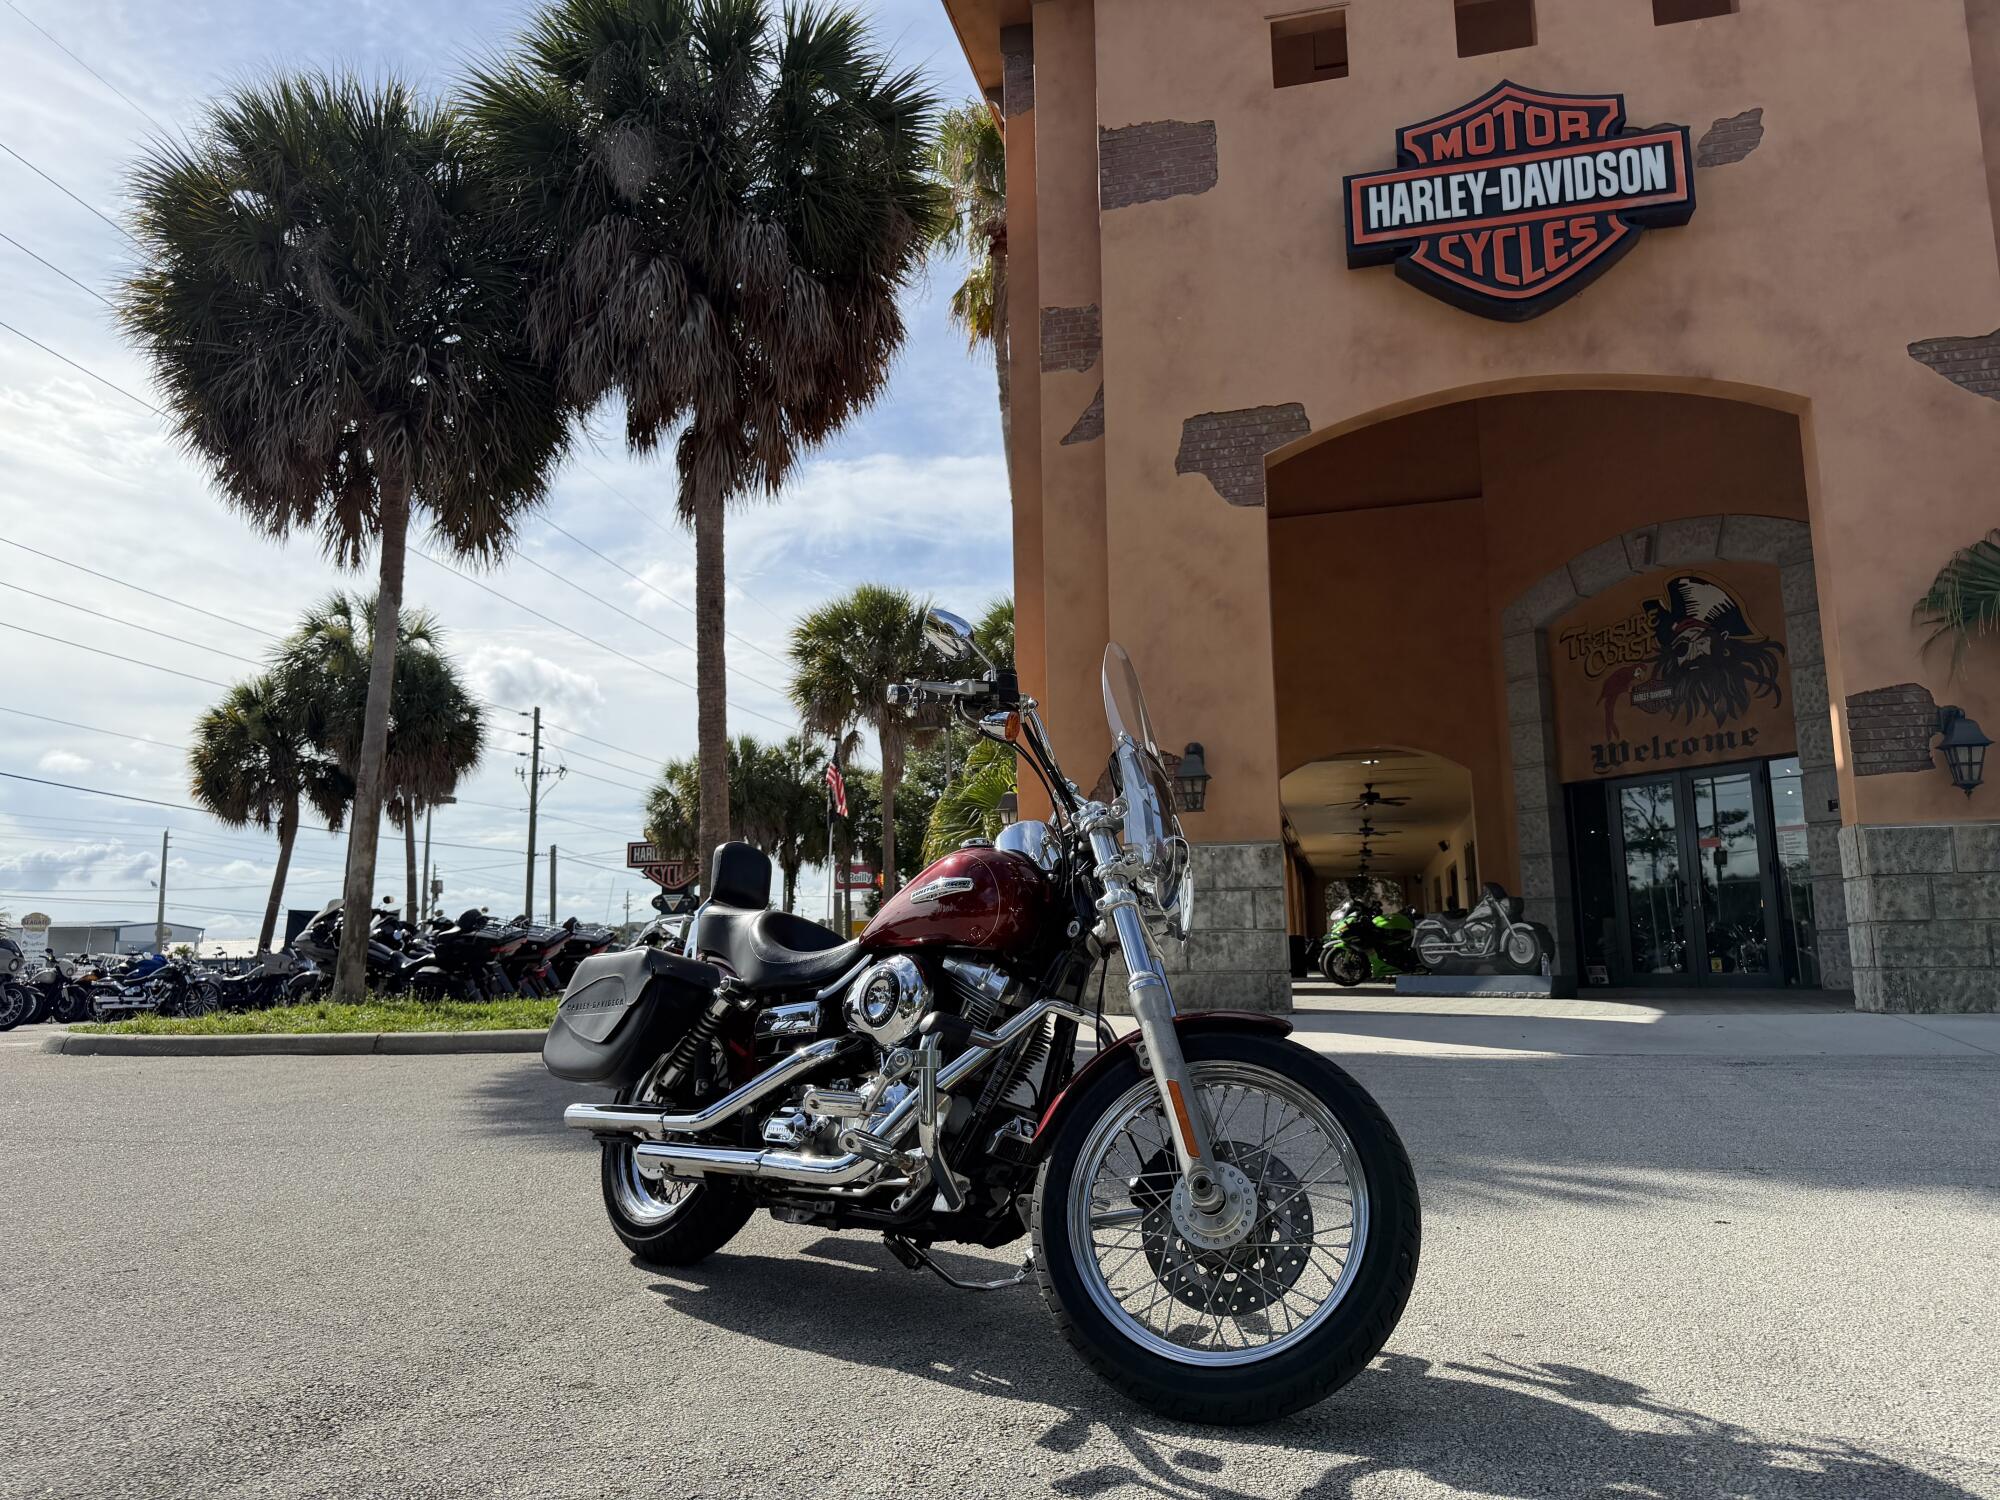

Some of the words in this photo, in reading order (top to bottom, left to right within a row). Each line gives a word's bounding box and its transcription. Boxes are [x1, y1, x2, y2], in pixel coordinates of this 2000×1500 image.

[1432, 99, 1590, 161] MOTOR
[1368, 145, 1668, 229] HARLEY-DAVIDSON
[1439, 215, 1598, 286] CYCLES
[1590, 727, 1759, 774] Welcome
[837, 870, 873, 884] OReilly
